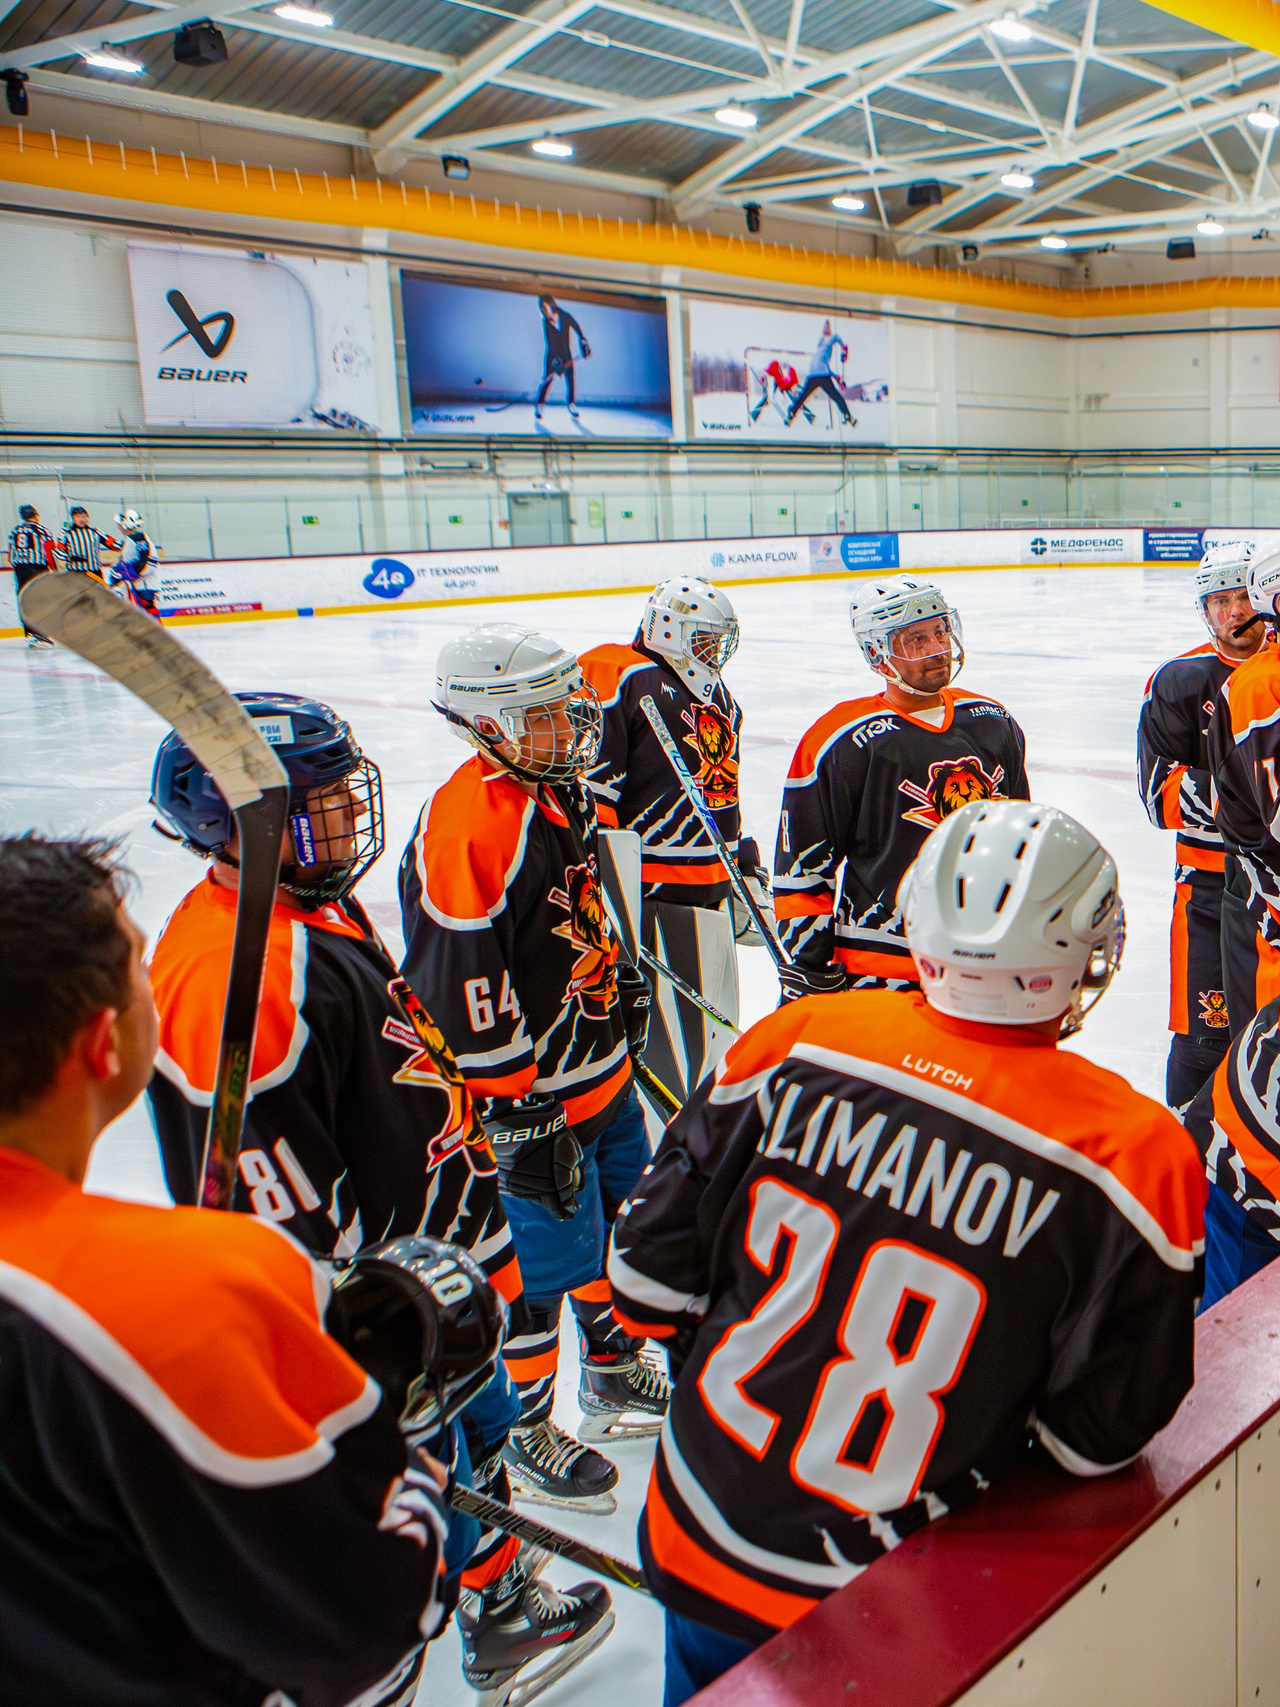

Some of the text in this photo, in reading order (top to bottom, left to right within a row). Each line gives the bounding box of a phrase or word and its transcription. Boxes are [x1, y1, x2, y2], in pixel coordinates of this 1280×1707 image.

[157, 367, 248, 384] BAUER
[1050, 538, 1124, 548] МЕДФРЕНДС
[728, 552, 798, 563] KAMA FLOW
[449, 683, 486, 694] BAUER
[702, 683, 713, 697] 9
[299, 817, 314, 866] BAUER
[952, 949, 997, 960] BAUER
[463, 968, 521, 1033] 64
[695, 995, 728, 1022] BAUER
[901, 1054, 974, 1091] LUTCH
[757, 1077, 1061, 1258] LIMANOV
[416, 1258, 474, 1307] 10
[696, 1173, 988, 1517] 28
[516, 1461, 548, 1483] BAUER
